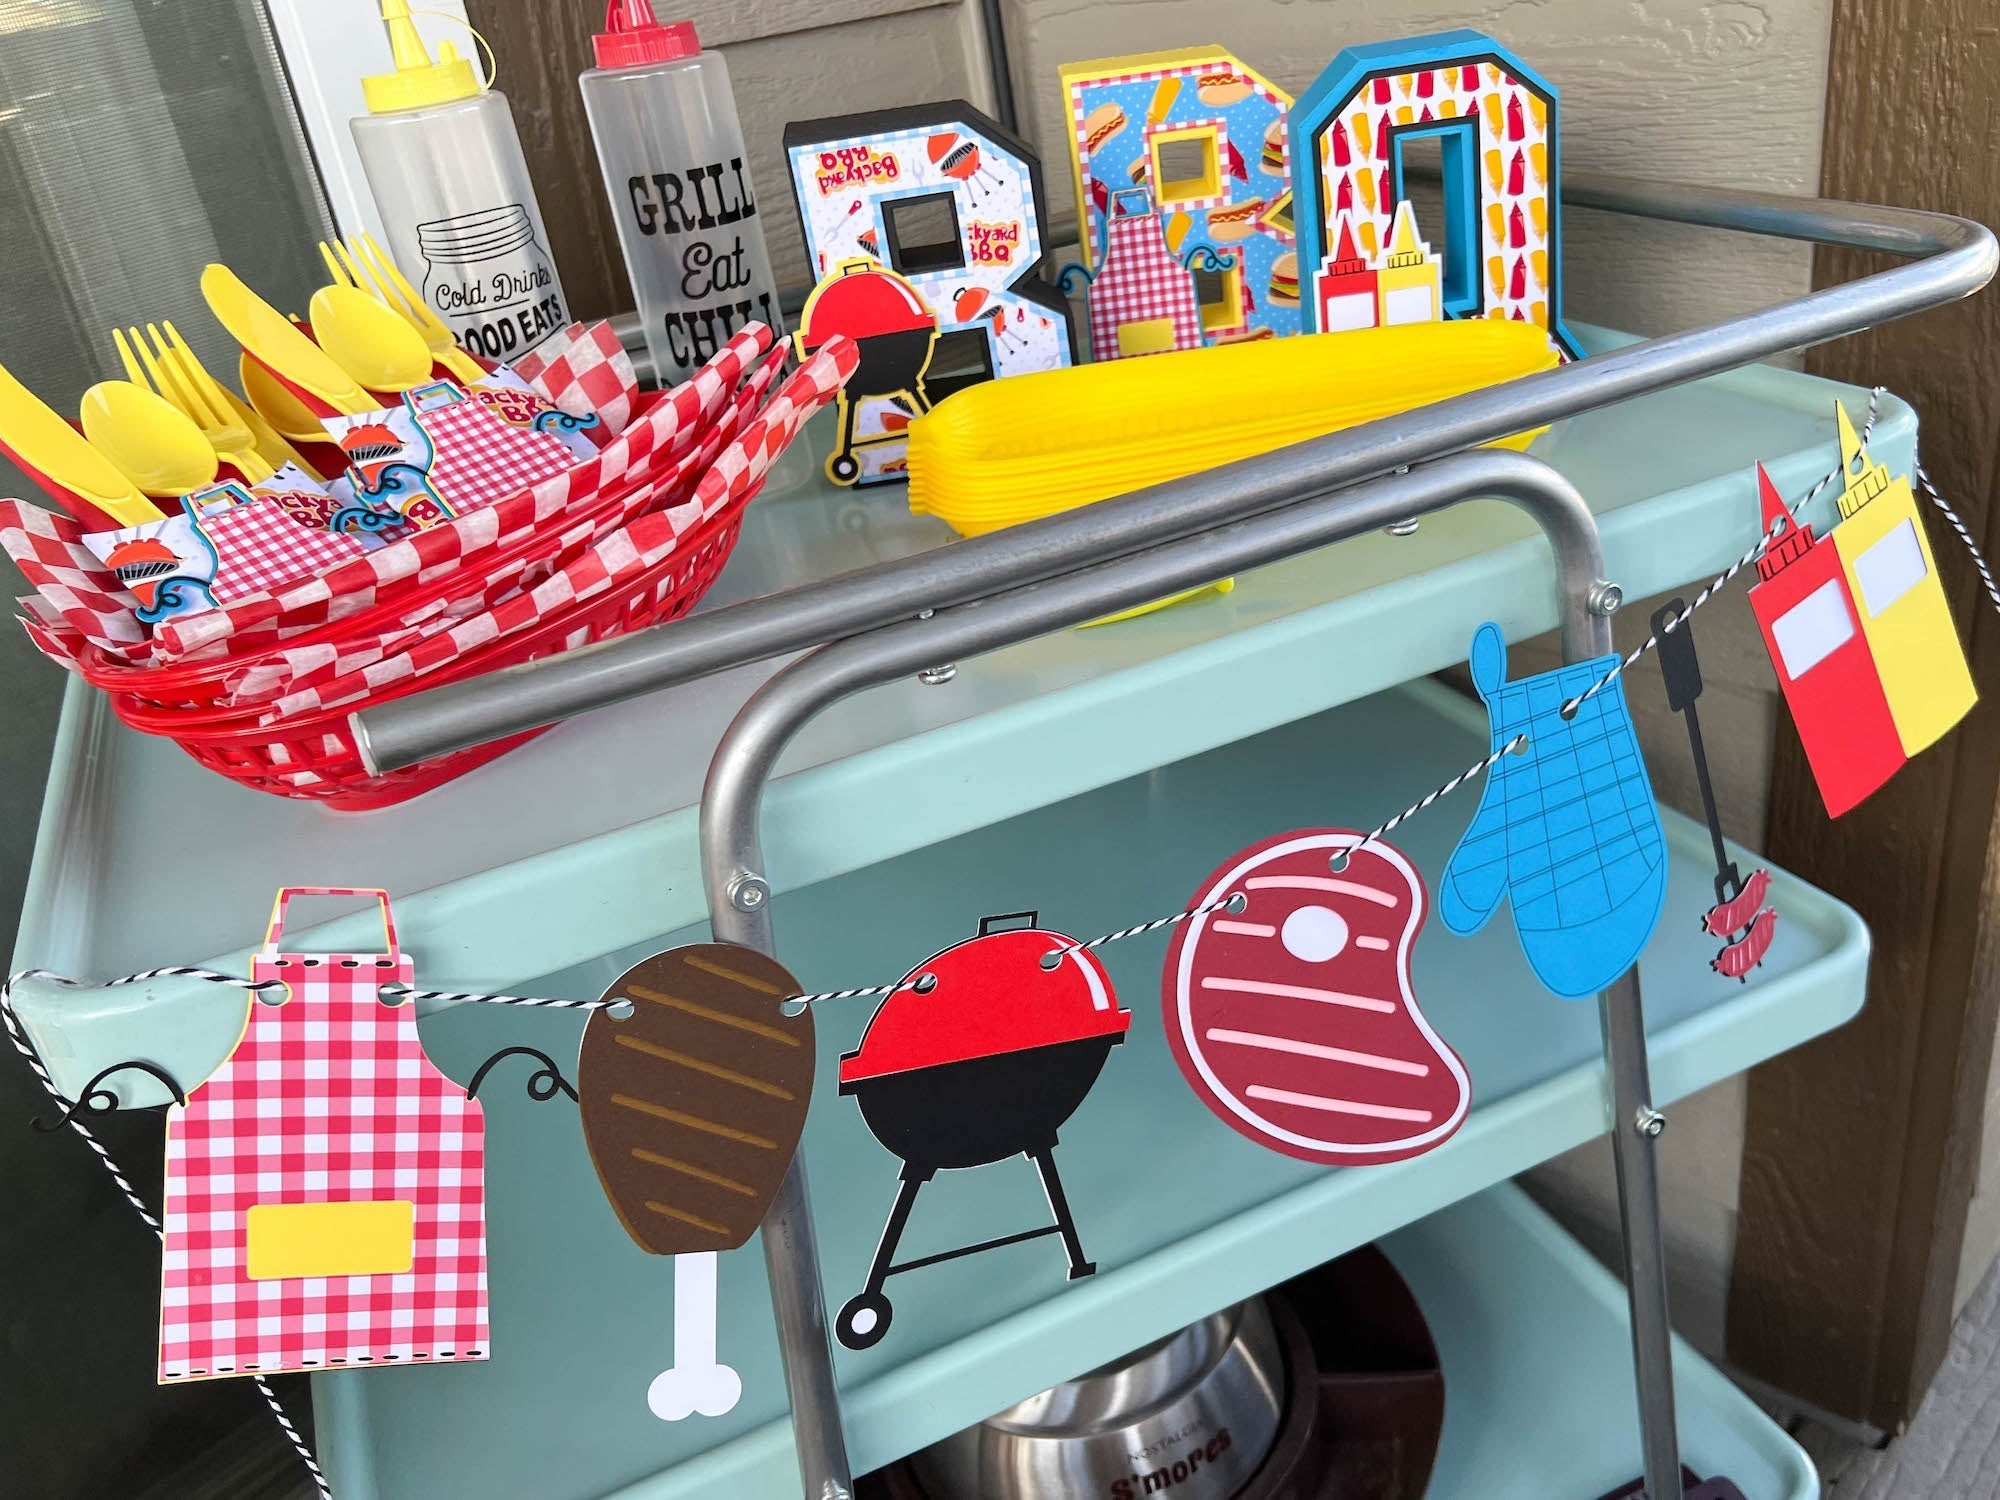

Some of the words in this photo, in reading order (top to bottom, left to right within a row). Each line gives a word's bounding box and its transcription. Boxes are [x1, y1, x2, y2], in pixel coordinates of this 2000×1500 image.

[628, 157, 756, 236] GRILL
[435, 280, 487, 311] Cold
[492, 263, 552, 302] Drinks
[681, 236, 750, 300] Eat
[450, 317, 517, 357] OOD
[517, 294, 562, 343] EATS
